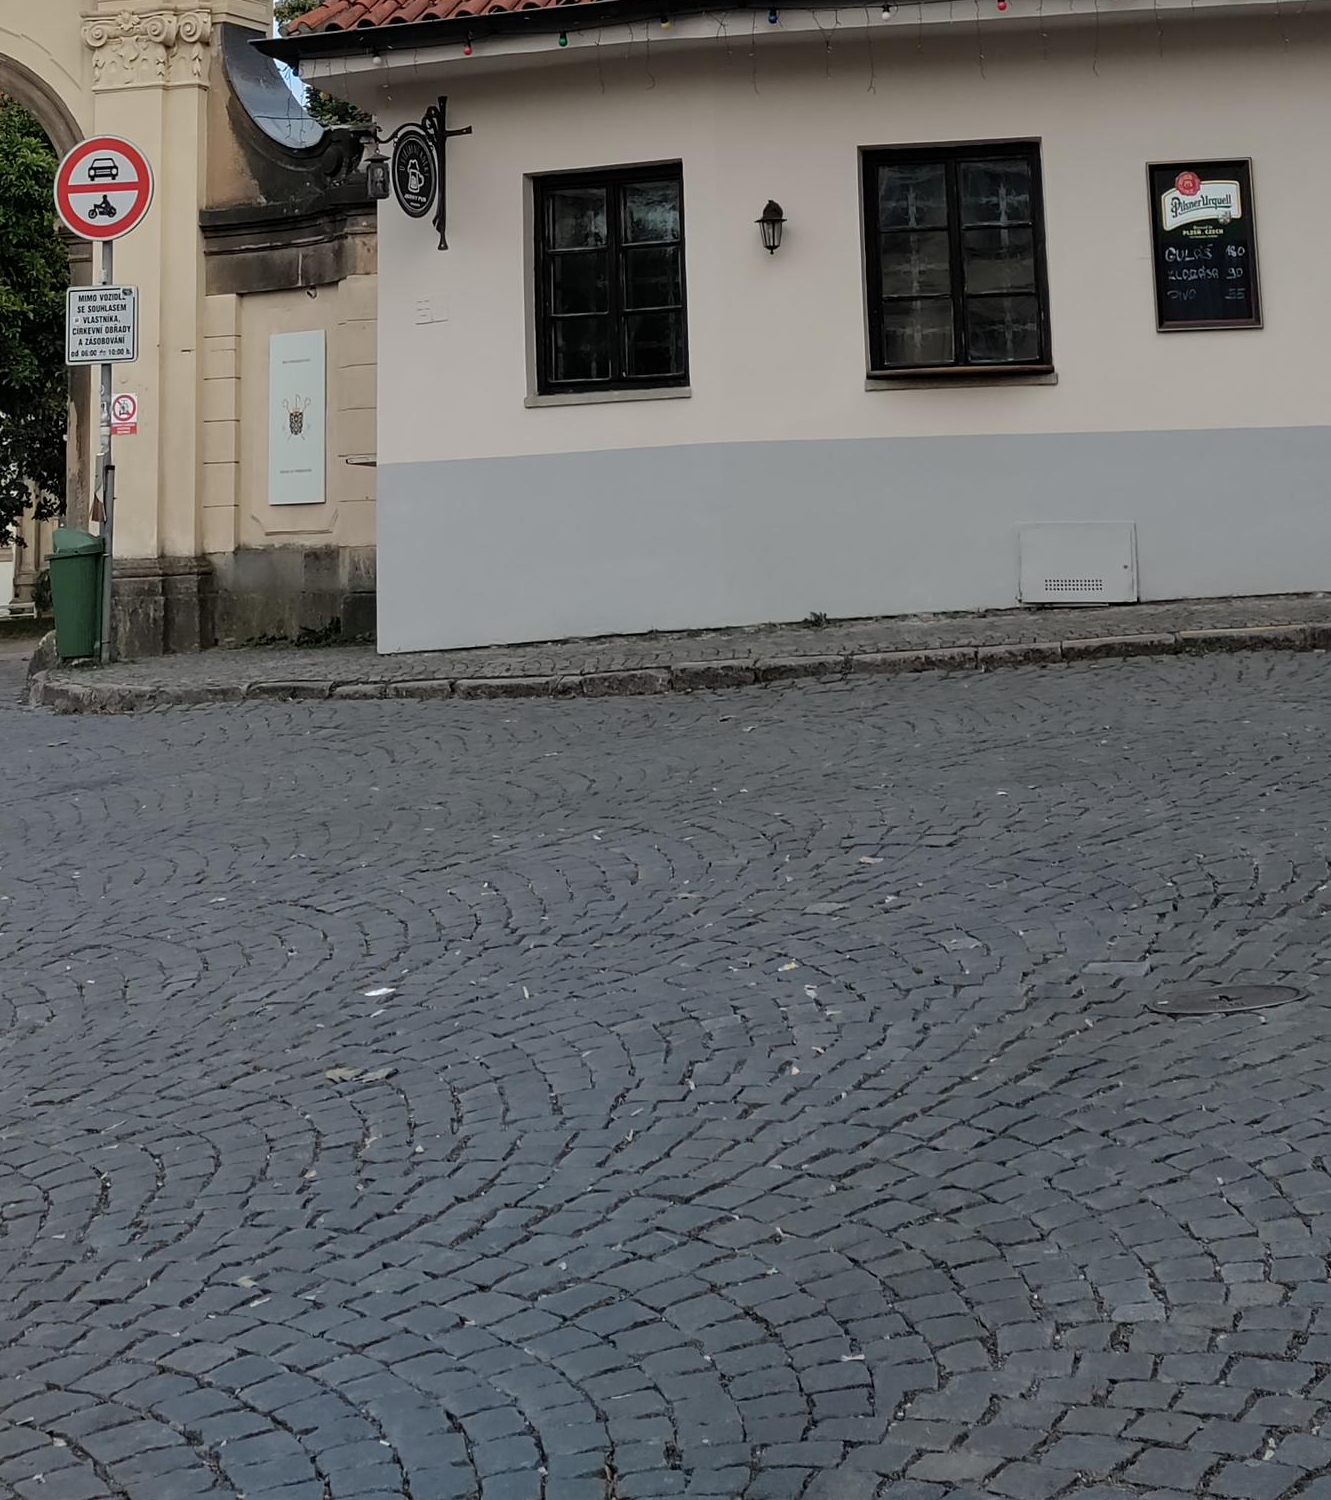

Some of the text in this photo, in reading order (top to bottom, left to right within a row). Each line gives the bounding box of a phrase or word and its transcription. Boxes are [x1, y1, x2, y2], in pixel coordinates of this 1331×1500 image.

[1171, 194, 1232, 218] Pilsner Urquell
[1226, 267, 1243, 279] 90
[78, 294, 97, 302] MIMO
[88, 304, 126, 313] SOUHLASEM
[105, 324, 131, 334] OBŘADY
